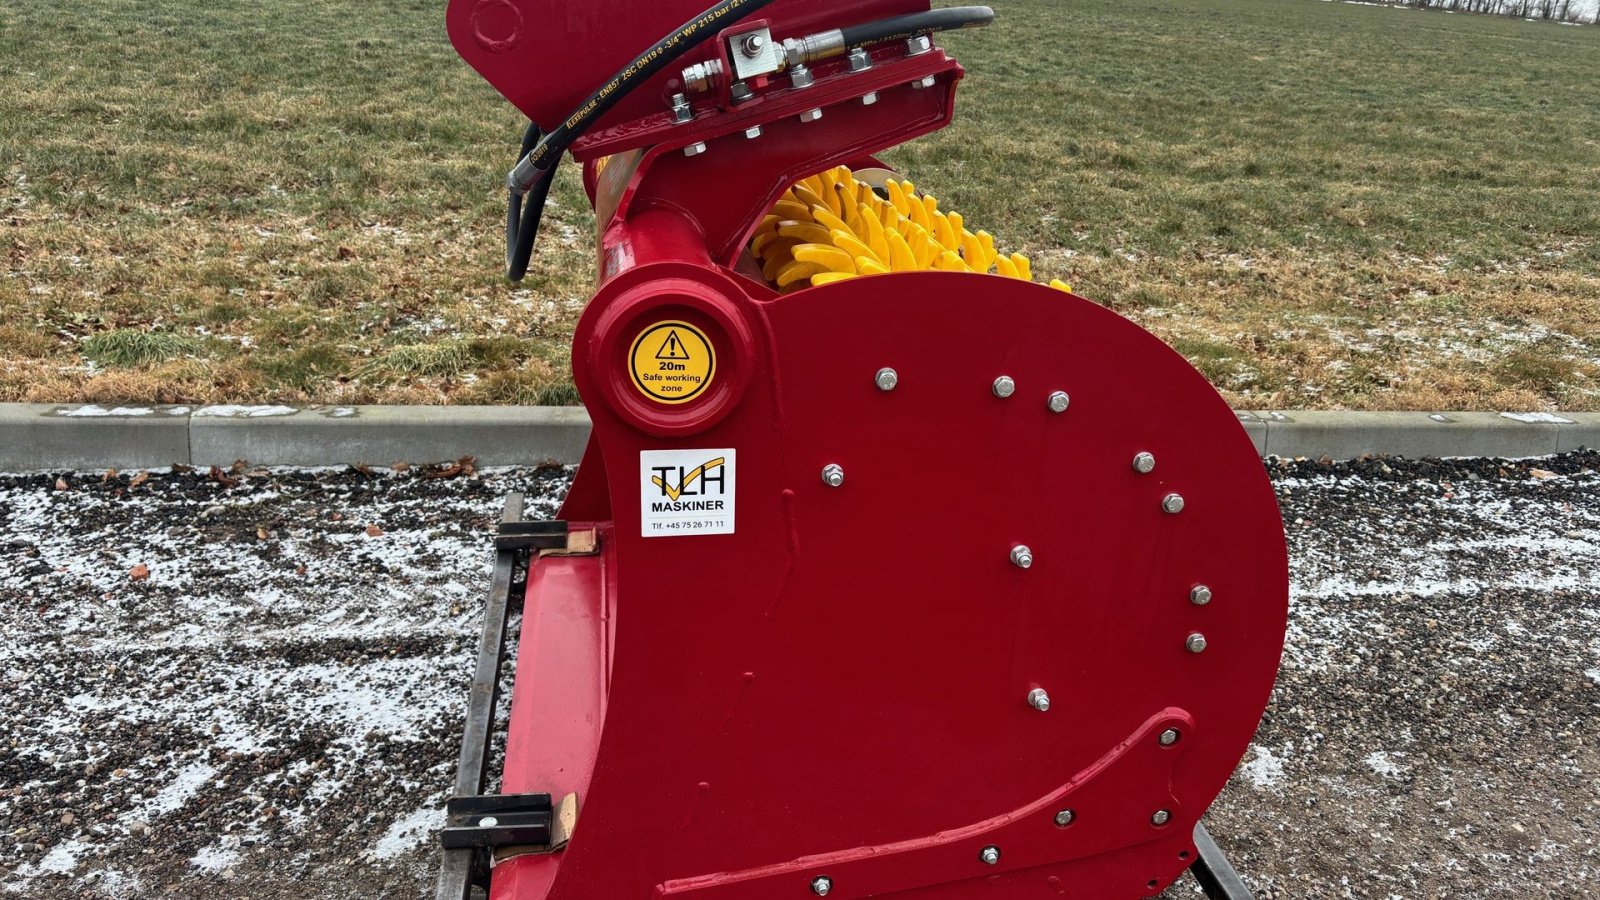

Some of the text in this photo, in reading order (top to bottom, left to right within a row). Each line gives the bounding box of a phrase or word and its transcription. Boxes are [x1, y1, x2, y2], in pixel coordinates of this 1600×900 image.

[600, 77, 620, 99] EN857
[621, 65, 637, 81] 2SC
[636, 50, 657, 69] DN19
[682, 24, 697, 37] WP
[698, 13, 714, 28] 215
[714, 5, 730, 18] bar
[659, 361, 686, 371] 20m
[643, 373, 701, 384] Safe working
[652, 464, 725, 496] TLH
[652, 500, 724, 513] MASKINER
[652, 522, 664, 530] Tlf.
[666, 522, 680, 530] +45
[682, 521, 692, 529] 75
[693, 521, 703, 529] 26
[704, 520, 713, 528] 71
